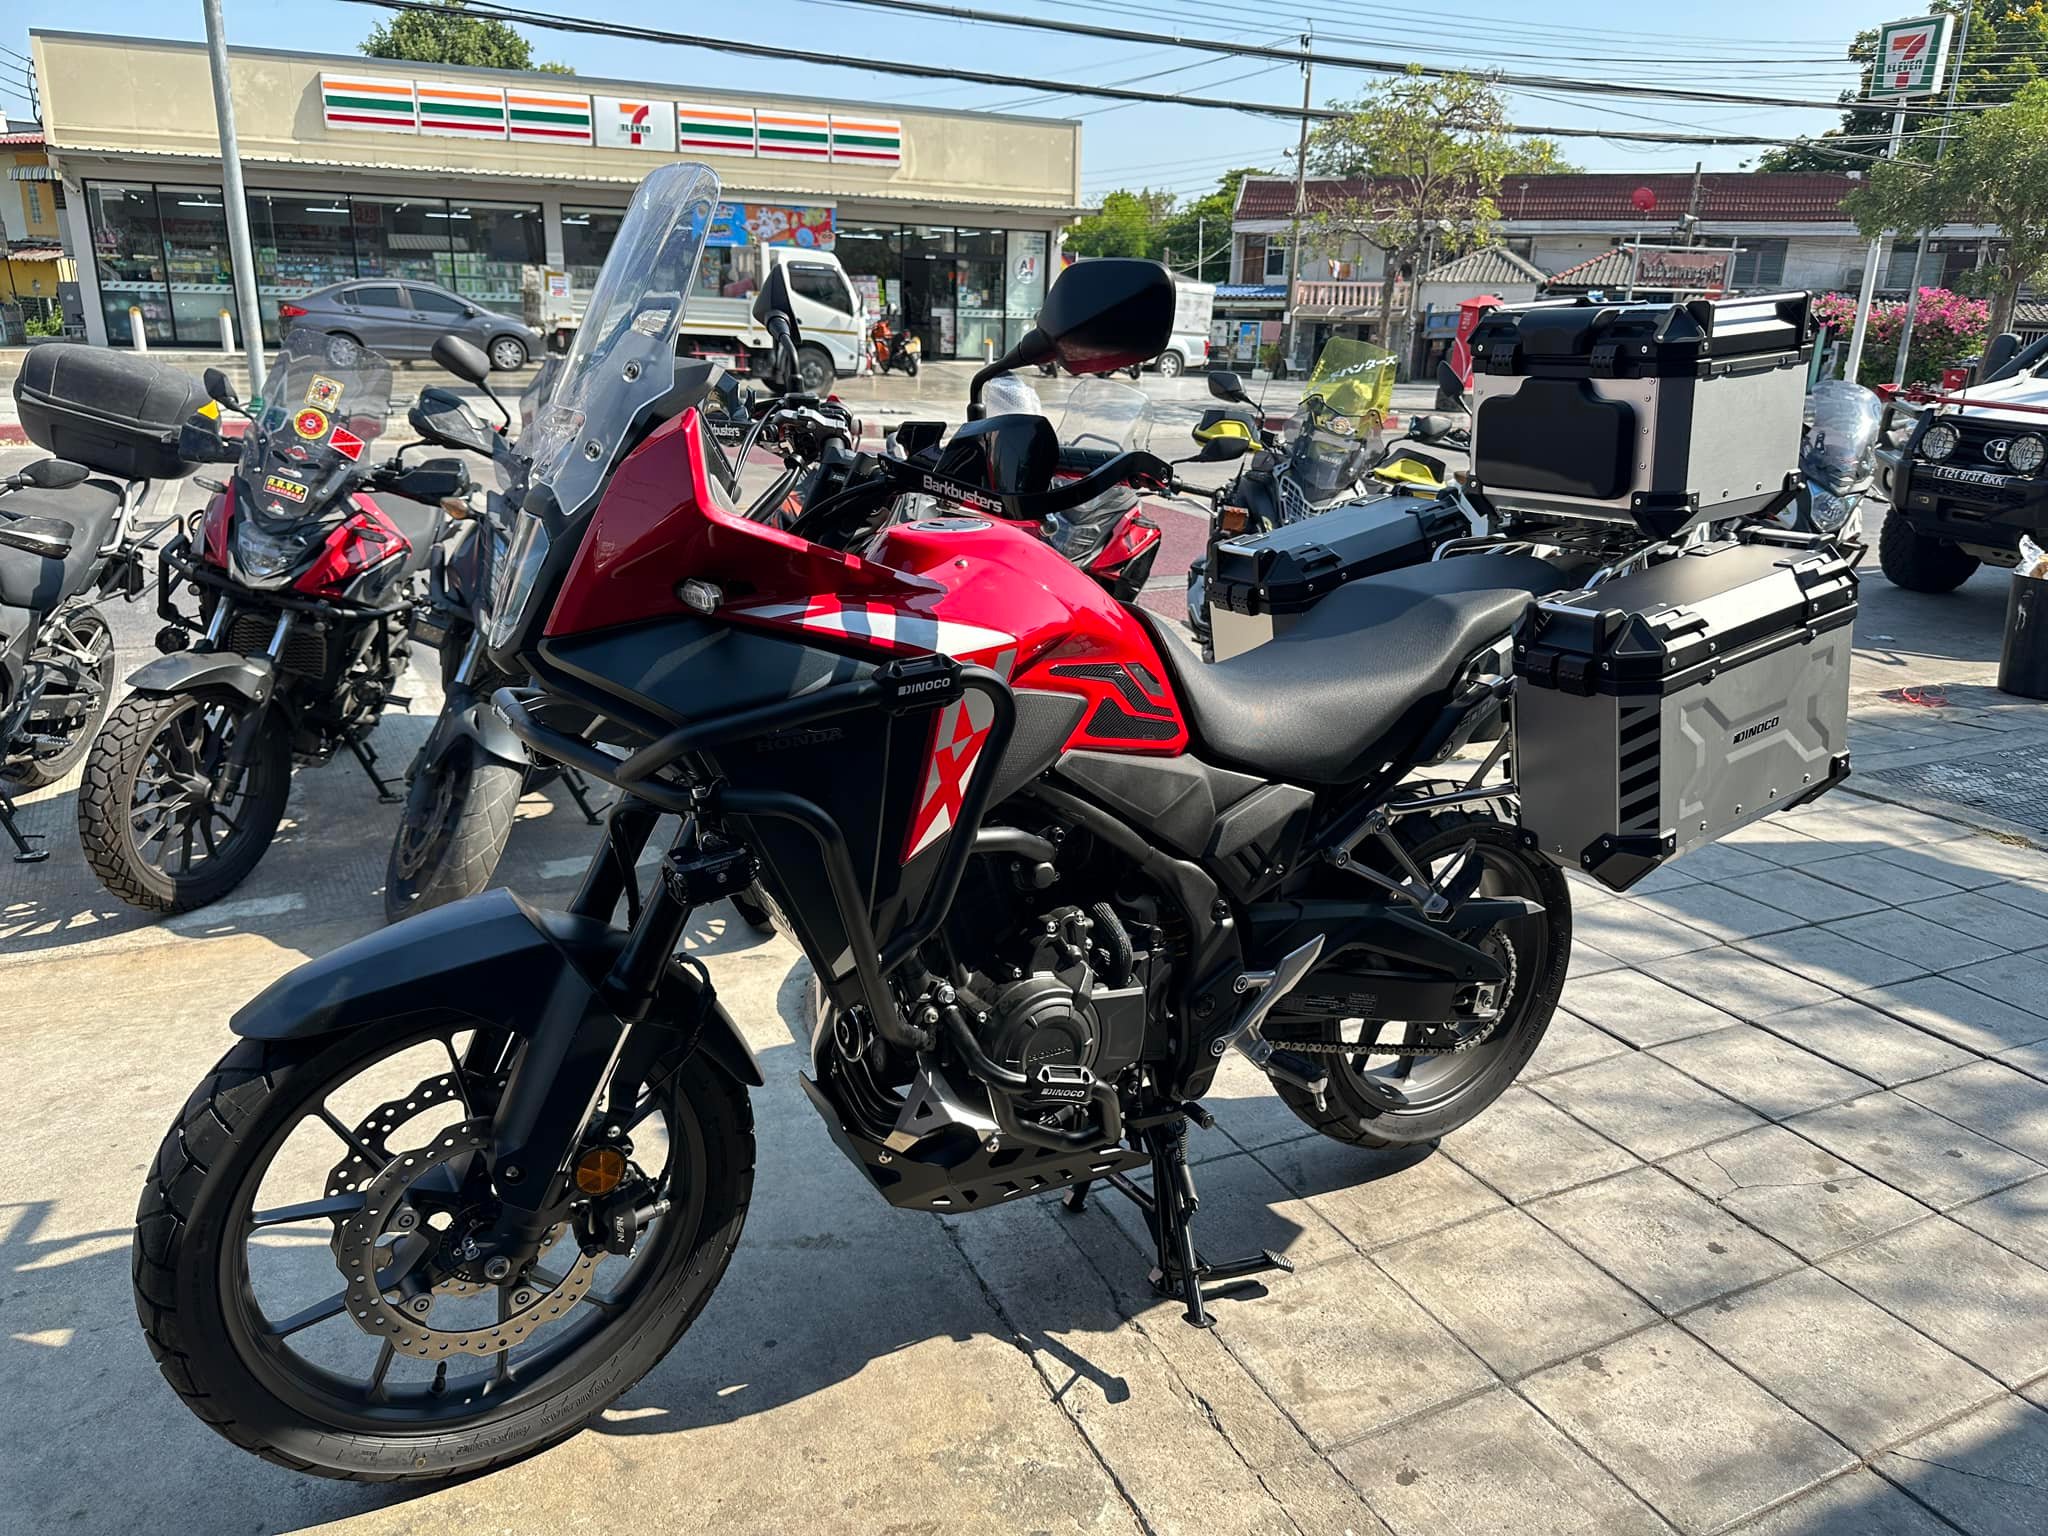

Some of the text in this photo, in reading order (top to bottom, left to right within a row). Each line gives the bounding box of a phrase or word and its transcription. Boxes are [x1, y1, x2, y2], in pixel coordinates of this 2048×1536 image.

[1892, 33, 1928, 88] 7
[618, 104, 649, 144] 7
[923, 474, 1002, 514] Barkbusters
[897, 677, 951, 696] DINOCO
[1733, 716, 1780, 744] DINOCO
